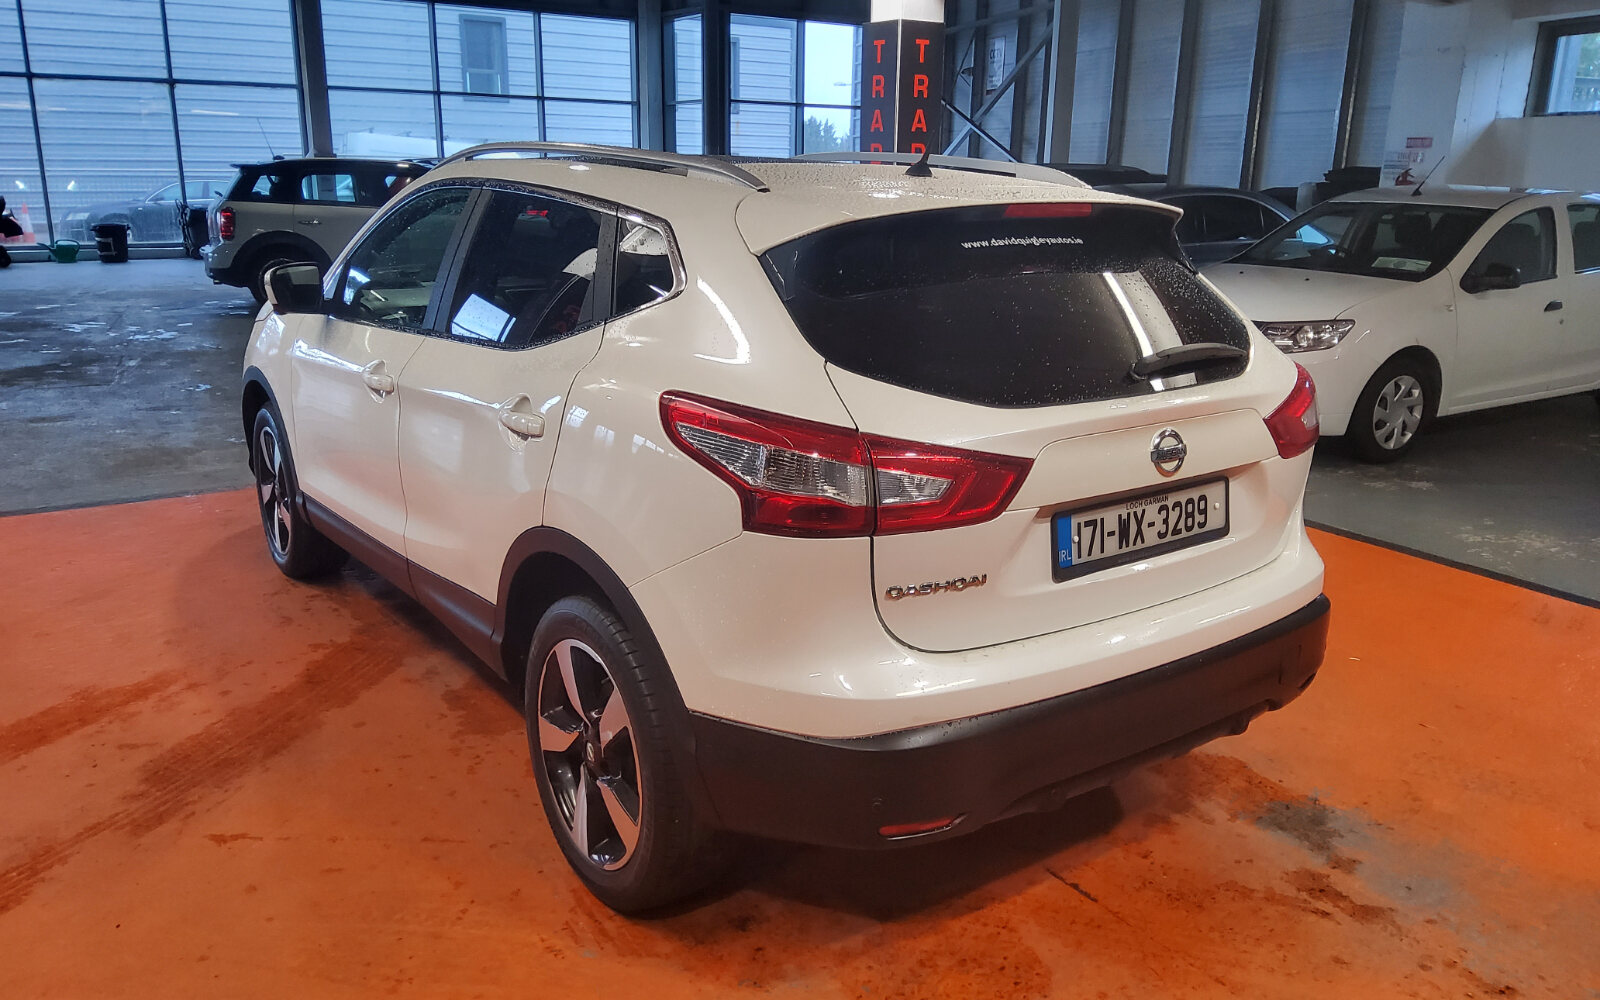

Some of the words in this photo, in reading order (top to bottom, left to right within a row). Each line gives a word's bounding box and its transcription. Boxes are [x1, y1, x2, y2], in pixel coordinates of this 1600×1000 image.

[961, 236, 1083, 248] www.davidquigleyautos.ie
[1125, 500, 1143, 511] LOCH
[1144, 495, 1168, 507] GARMAN
[1077, 494, 1208, 560] 171-WX-3289
[1058, 550, 1072, 563] IRL
[884, 574, 987, 601] QASHQAI
